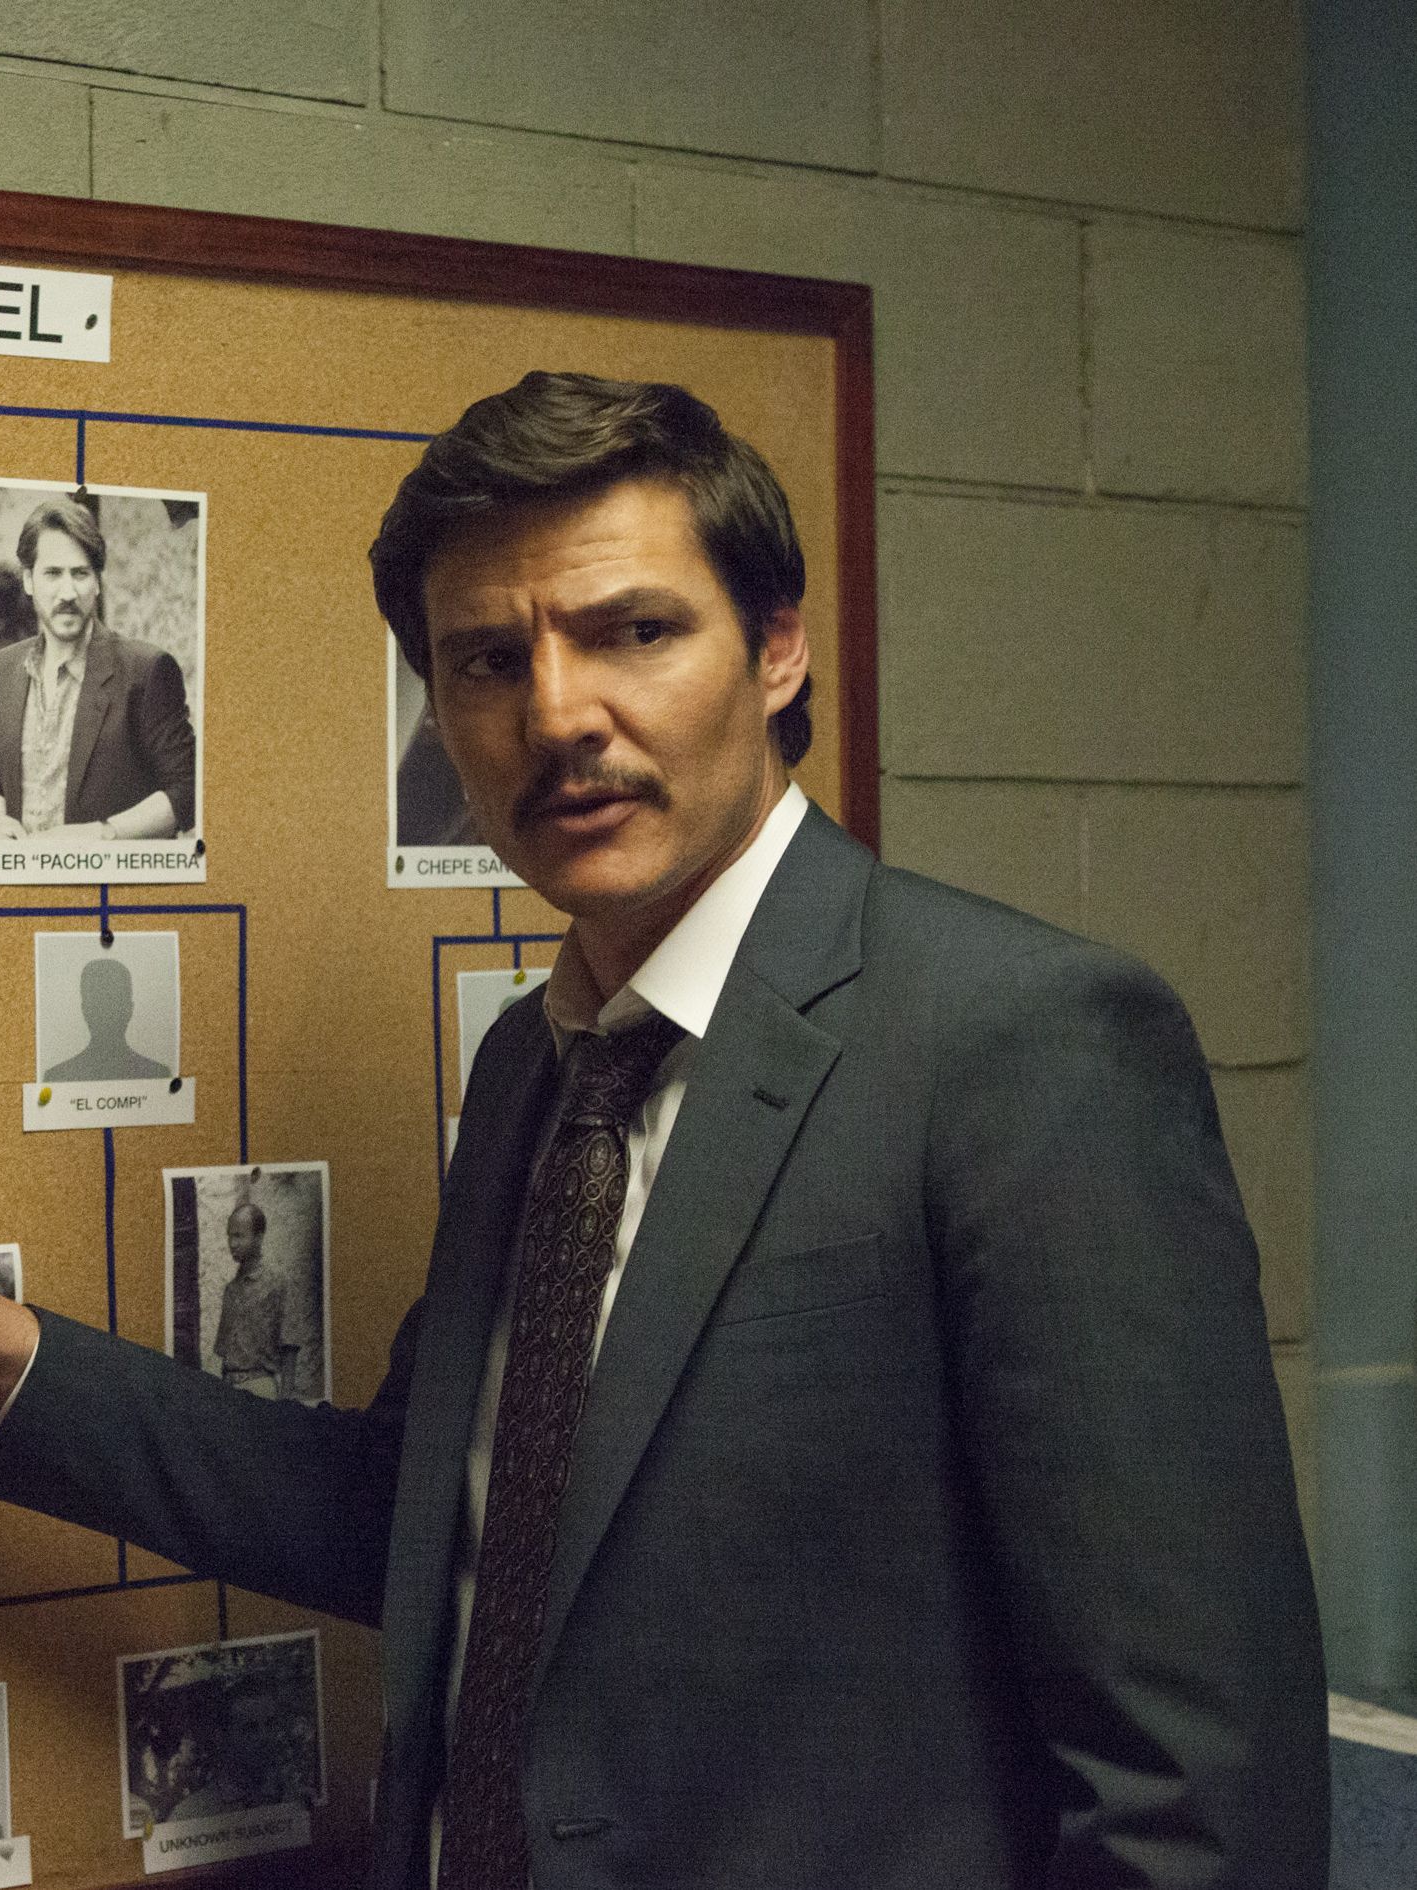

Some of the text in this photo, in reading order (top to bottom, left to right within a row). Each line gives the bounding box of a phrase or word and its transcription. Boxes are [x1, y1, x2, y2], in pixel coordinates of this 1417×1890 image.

[32, 853, 111, 870] “PACHO”
[117, 852, 200, 870] HERRERA
[417, 859, 473, 875] CHEPE
[70, 1096, 148, 1112] “EL COMPI”
